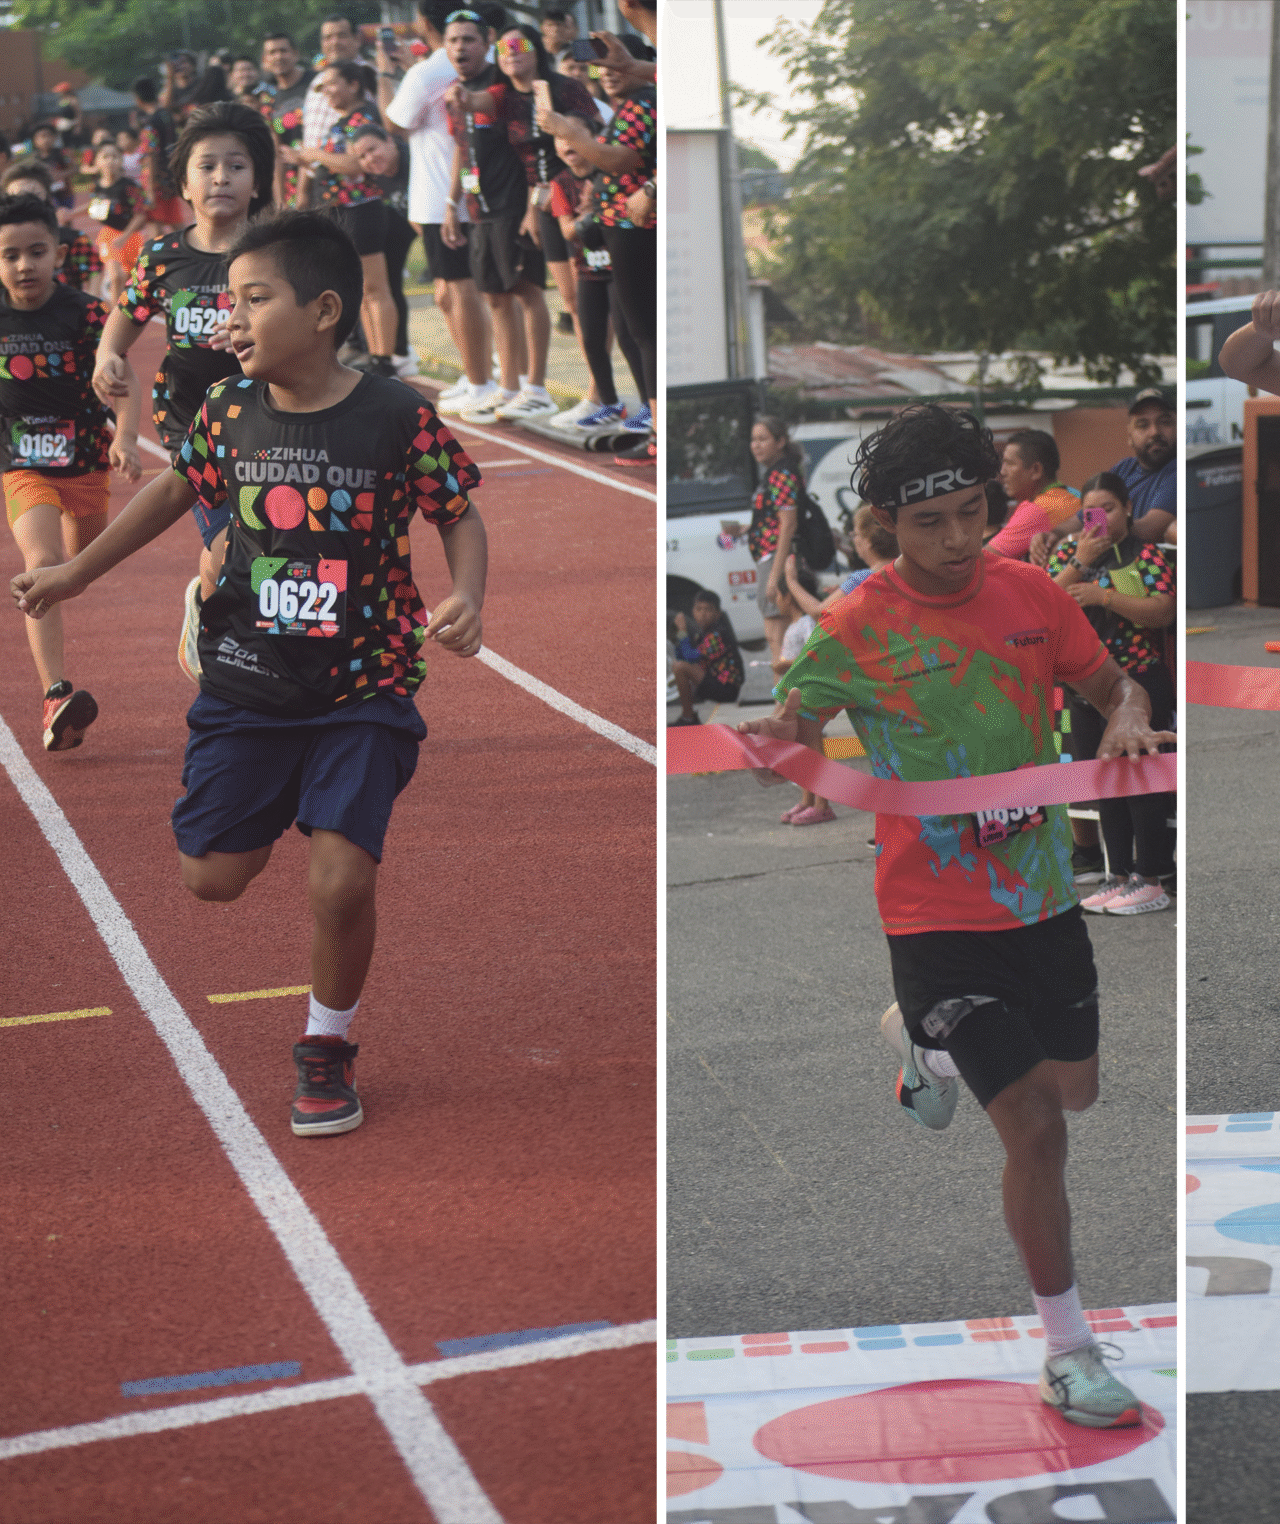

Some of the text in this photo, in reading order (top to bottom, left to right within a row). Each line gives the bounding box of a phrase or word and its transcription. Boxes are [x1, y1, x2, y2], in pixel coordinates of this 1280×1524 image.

[190, 284, 228, 294] ZIHU
[19, 433, 68, 458] 0162
[270, 447, 329, 463] ZIHUA
[235, 461, 377, 489] CIUDAD QUE
[259, 578, 338, 622] 0622
